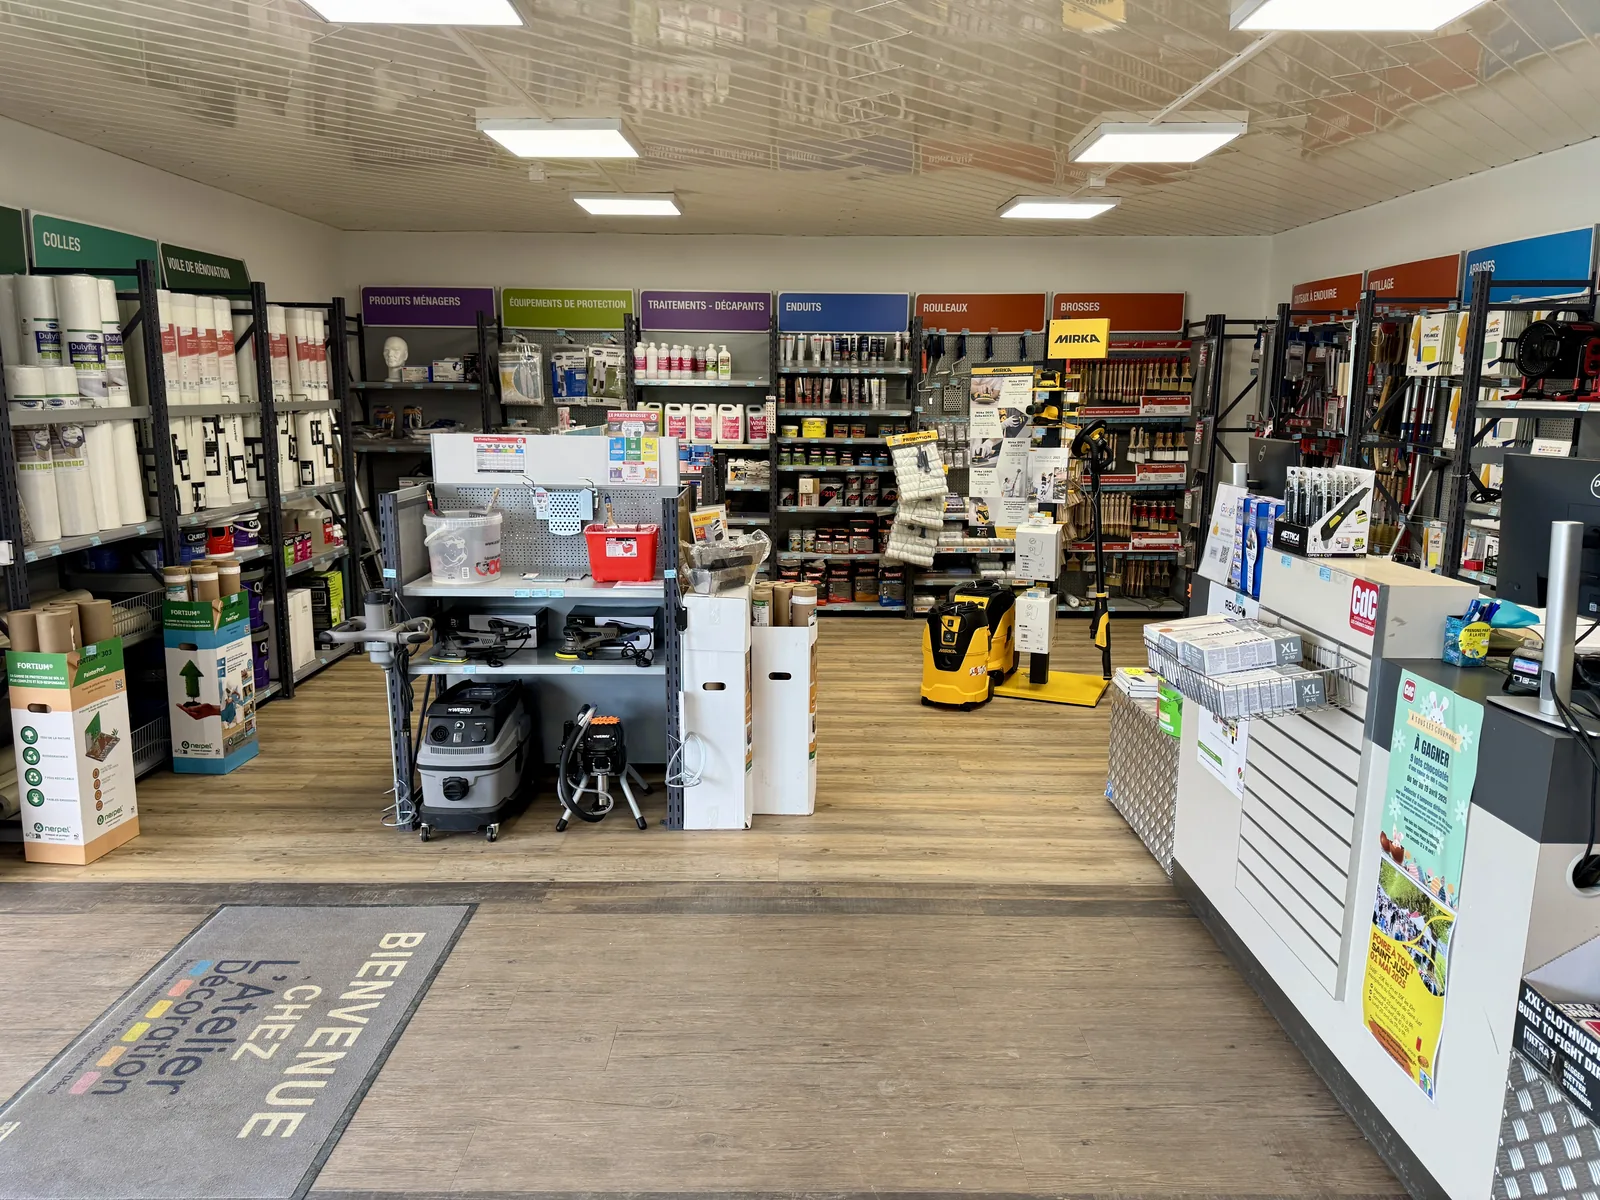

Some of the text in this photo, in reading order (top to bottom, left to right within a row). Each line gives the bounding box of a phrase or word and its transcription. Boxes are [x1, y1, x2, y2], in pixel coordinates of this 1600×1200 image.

[43, 232, 80, 252] COLLES
[167, 257, 230, 280] VOILE DE RÉNOVATION
[1310, 288, 1337, 301] À ENDUIRE
[1370, 278, 1394, 290] OUTILLAGE
[369, 294, 460, 306] PRODUITS MÉNAGERS
[510, 297, 626, 309] ÉQUIPEMENTS DE PROTECTION
[648, 300, 706, 310] TRAITEMENTS
[715, 299, 764, 311] DÉCAPANTS
[786, 302, 822, 312] ENDUITS
[923, 303, 968, 312] ROULEAUX
[1060, 302, 1100, 312] BROSSES
[1054, 334, 1100, 343] MIRKA
[1221, 503, 1235, 516] Google
[1352, 585, 1377, 620] CdC
[102, 649, 112, 658] 303
[1281, 642, 1298, 653] XL
[1302, 685, 1320, 695] XL
[1414, 715, 1425, 727] TOUS
[1425, 720, 1434, 732] LES
[1414, 732, 1449, 769] À GAGNER
[1413, 755, 1423, 768] lots
[1423, 759, 1449, 784] chocolatés
[1372, 932, 1415, 974] FOIRE À TOUT
[1372, 942, 1409, 980] SAINT-JUST
[1370, 952, 1406, 989] 01 MAI 2025
[91, 960, 249, 1096] Décoration
[147, 960, 300, 1096] L'Atelier
[230, 984, 323, 1061] CHEZ
[1518, 1000, 1542, 1028] BUILT
[1543, 1021, 1554, 1040] TO
[1554, 1033, 1584, 1064] FIGHT
[236, 932, 426, 1139] BIENVENUE
[1526, 1031, 1550, 1059] ULTRA
[1563, 1069, 1588, 1096] WETTER.
[1562, 1079, 1593, 1111] STRONGER.
